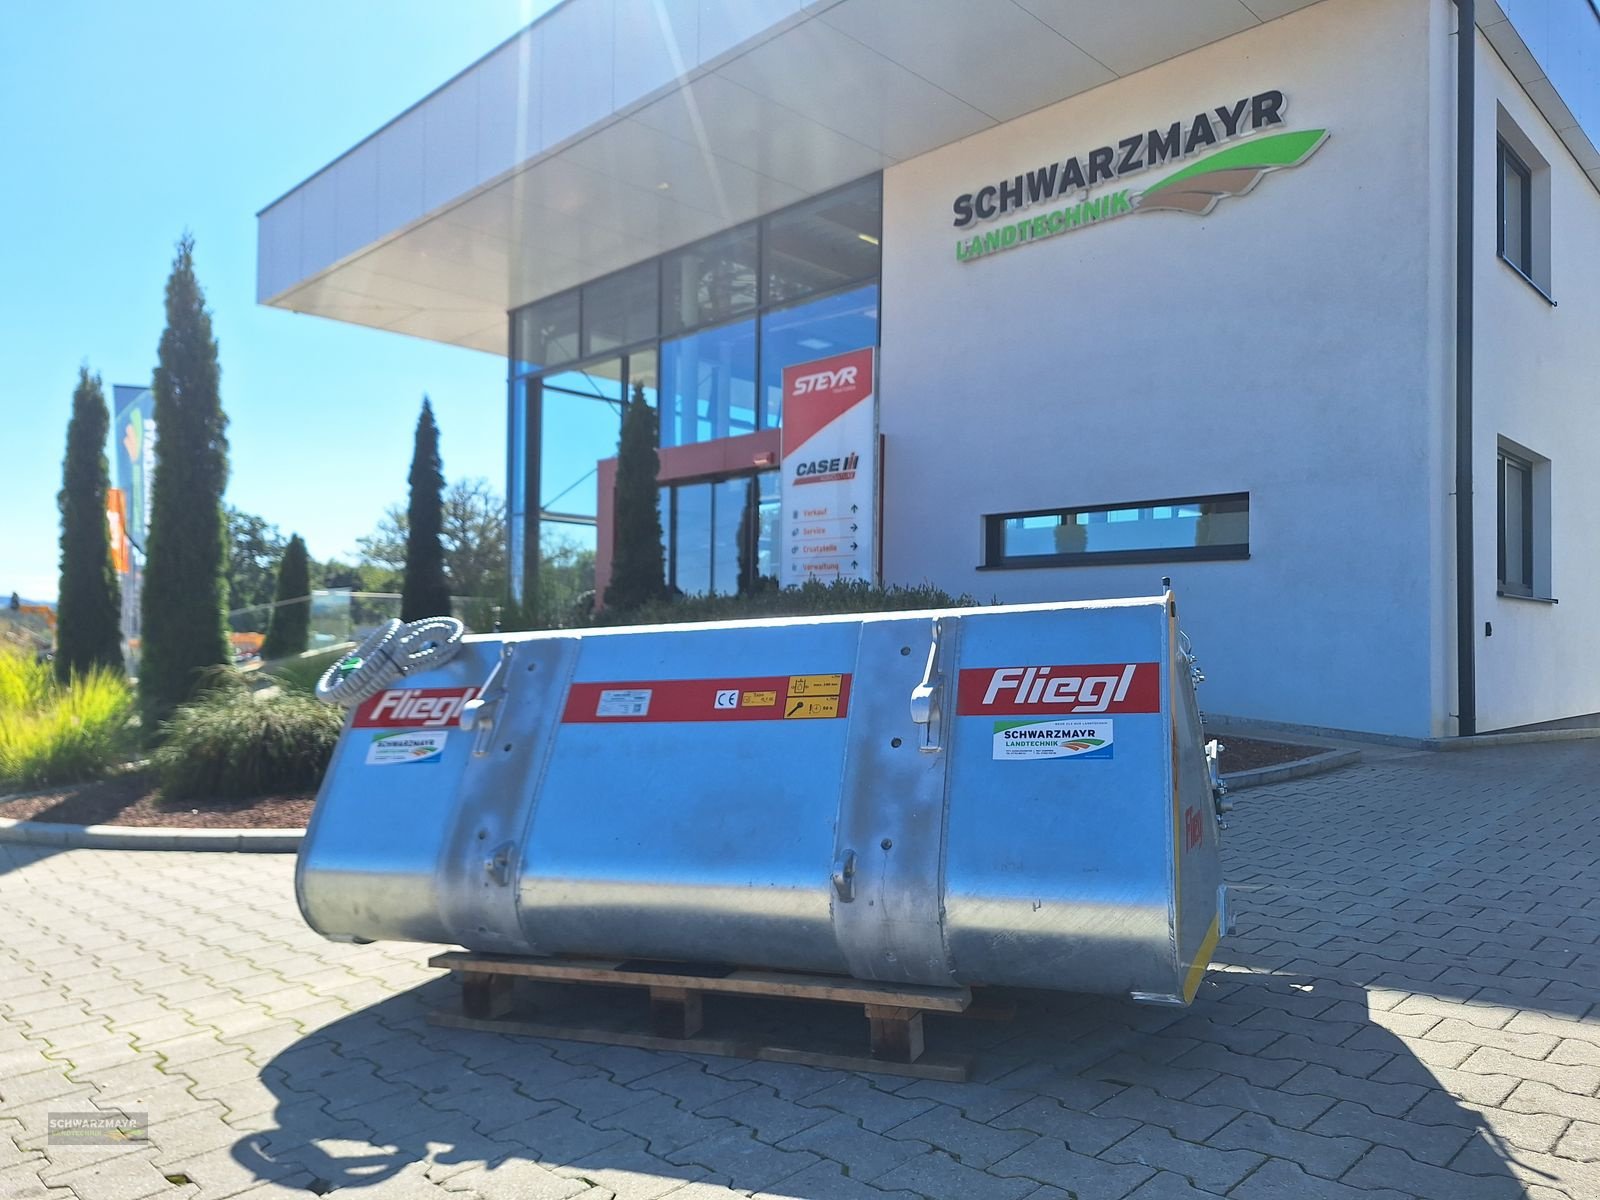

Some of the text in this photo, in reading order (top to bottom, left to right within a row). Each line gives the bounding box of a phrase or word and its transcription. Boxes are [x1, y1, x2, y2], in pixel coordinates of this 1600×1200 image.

[953, 89, 1285, 227] SCHWARZMAYR
[956, 189, 1133, 262] LANDTECHNIK
[792, 366, 858, 396] STEYR
[796, 458, 841, 477] CASE
[717, 692, 737, 706] CE
[982, 664, 1137, 712] Fliegl
[370, 687, 476, 726] Fliegl
[1004, 729, 1096, 739] SCHWARZMAYR
